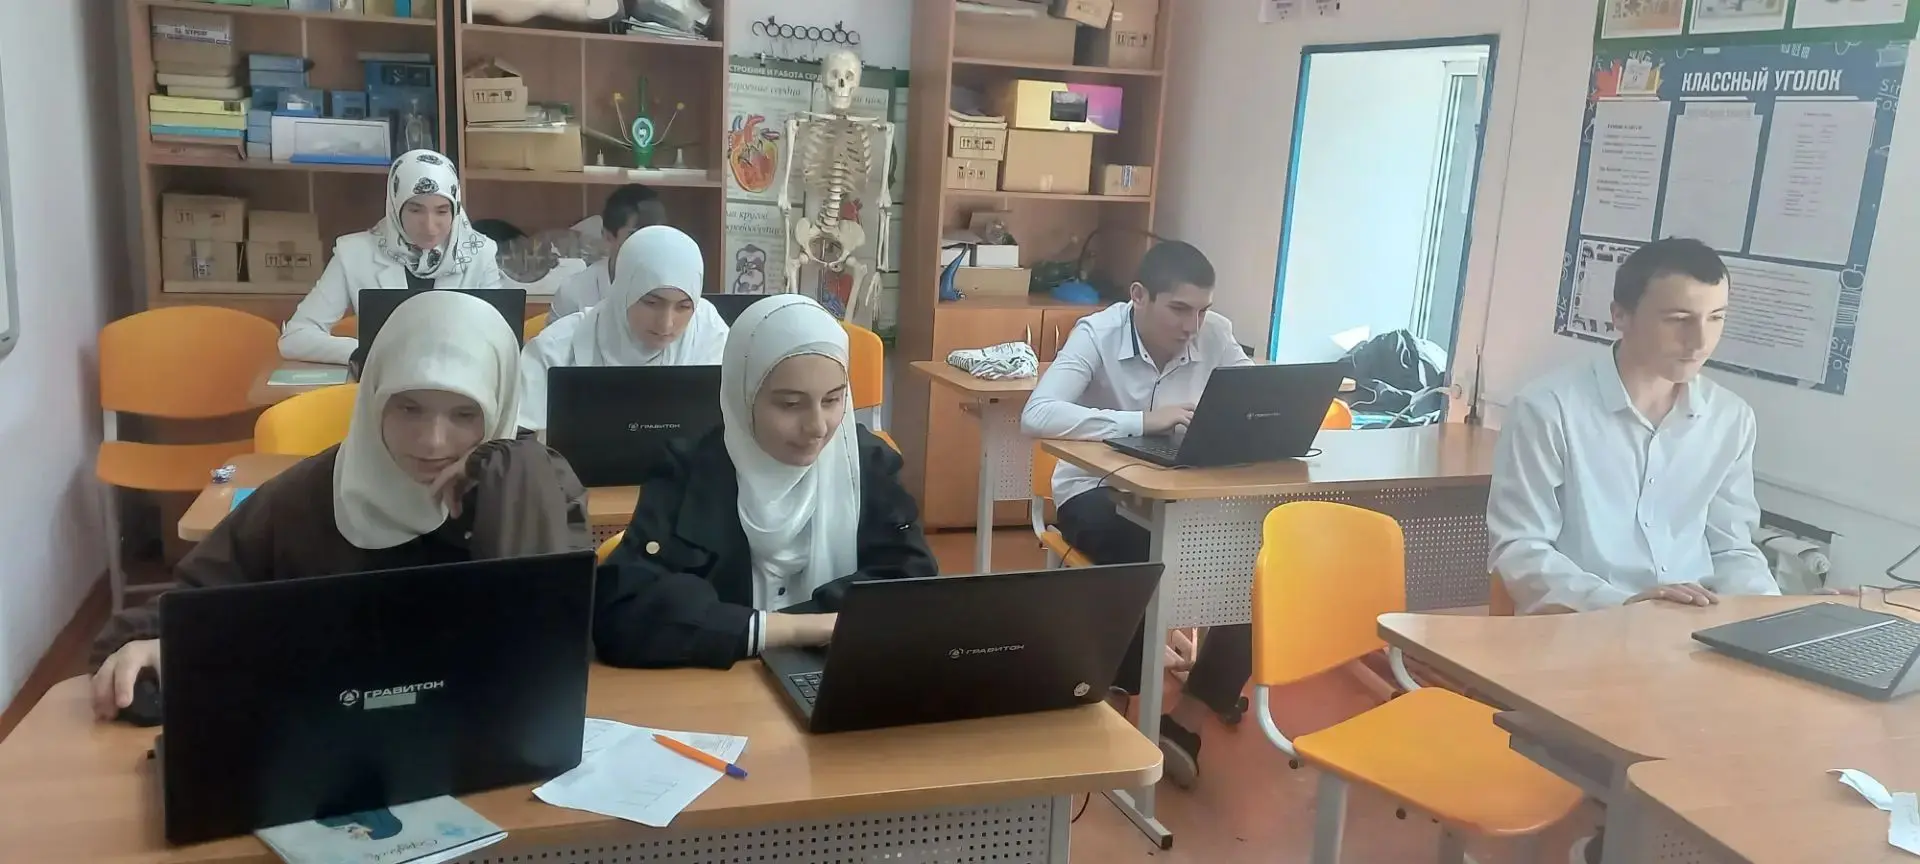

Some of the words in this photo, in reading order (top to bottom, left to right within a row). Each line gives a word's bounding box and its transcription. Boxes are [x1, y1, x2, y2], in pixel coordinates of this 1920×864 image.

[774, 68, 804, 80] РАБОТА
[1681, 66, 1769, 92] КЛАССНЫЙ
[1773, 69, 1843, 92] УГОЛОК
[966, 644, 1024, 655] ГРАВИТОН
[364, 680, 444, 699] ГРАВИТОН
